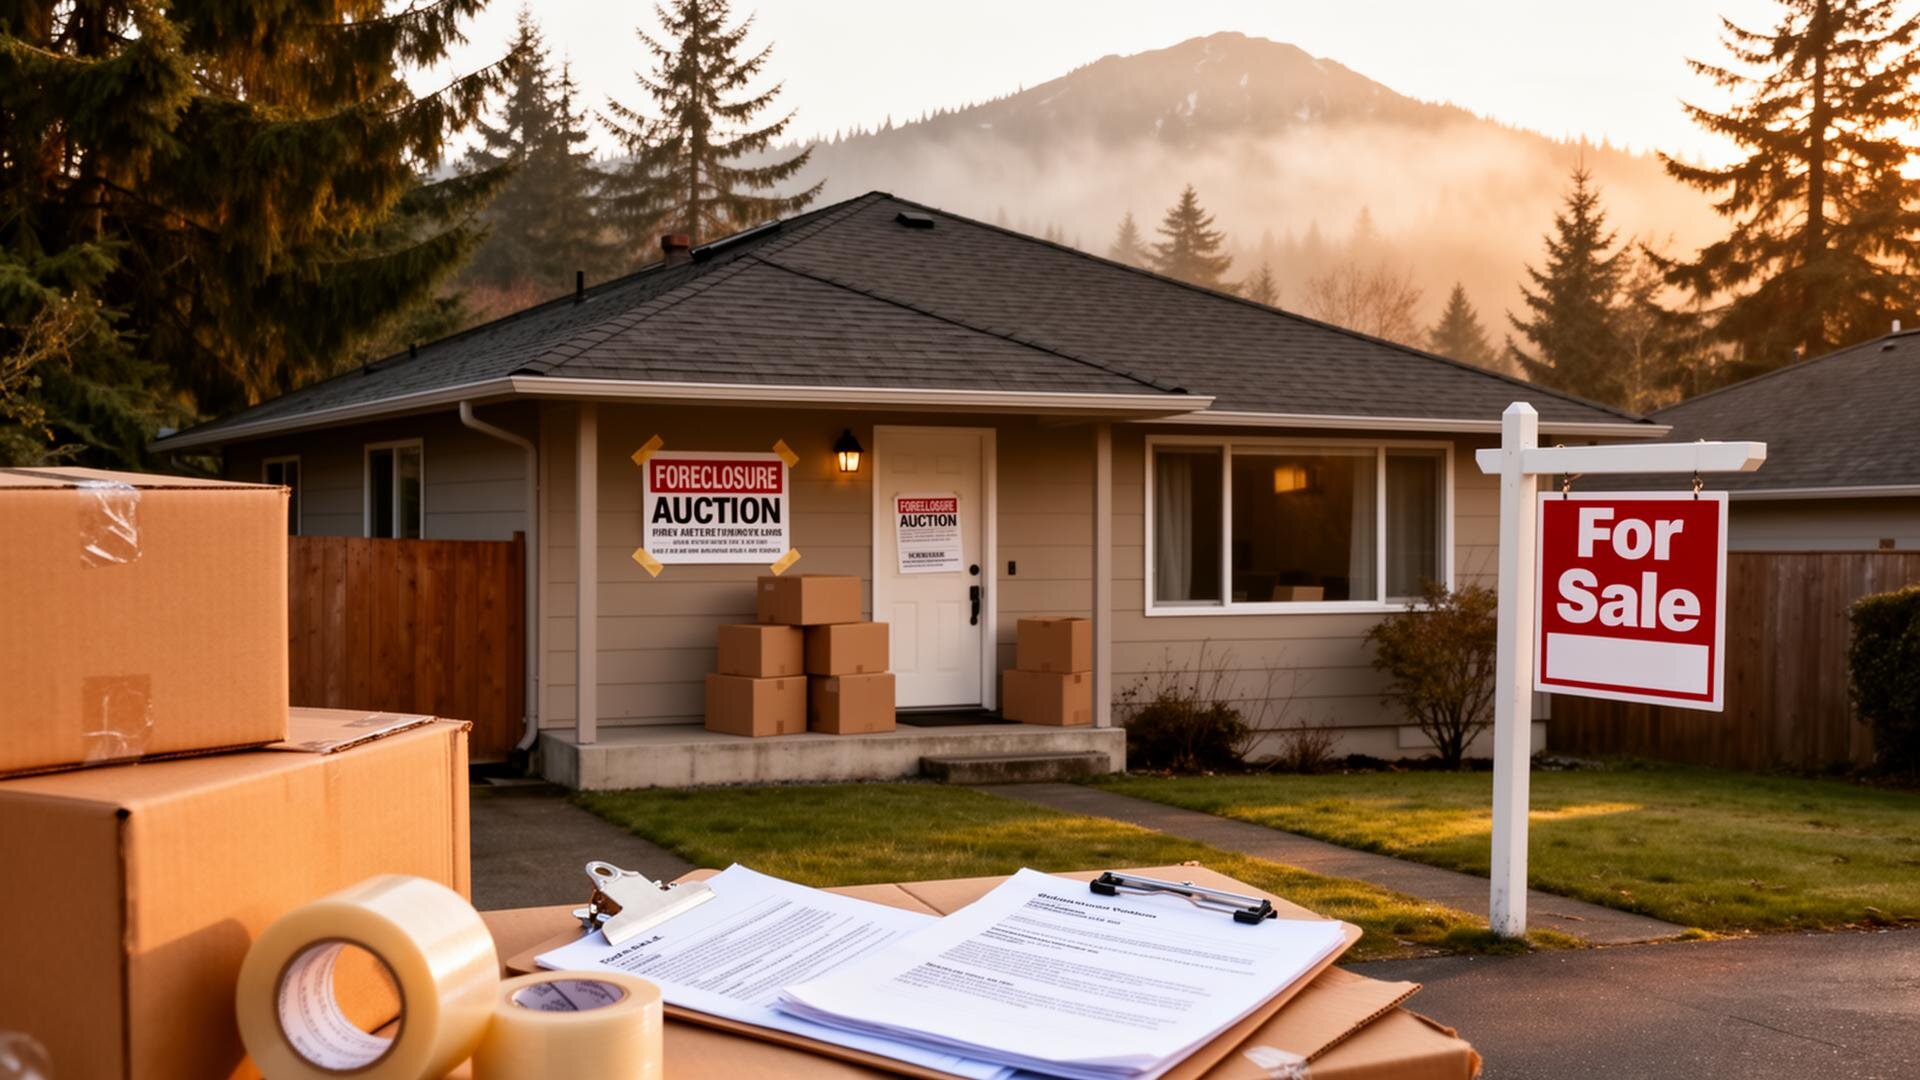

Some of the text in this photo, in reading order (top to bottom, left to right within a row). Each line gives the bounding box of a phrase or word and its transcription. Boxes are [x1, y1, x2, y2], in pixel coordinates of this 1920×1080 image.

[655, 464, 778, 490] FORECLOSURE
[652, 496, 781, 524] AUCTION
[900, 514, 957, 528] AUCTION
[1577, 507, 1684, 561] For
[1556, 567, 1701, 632] Sale
